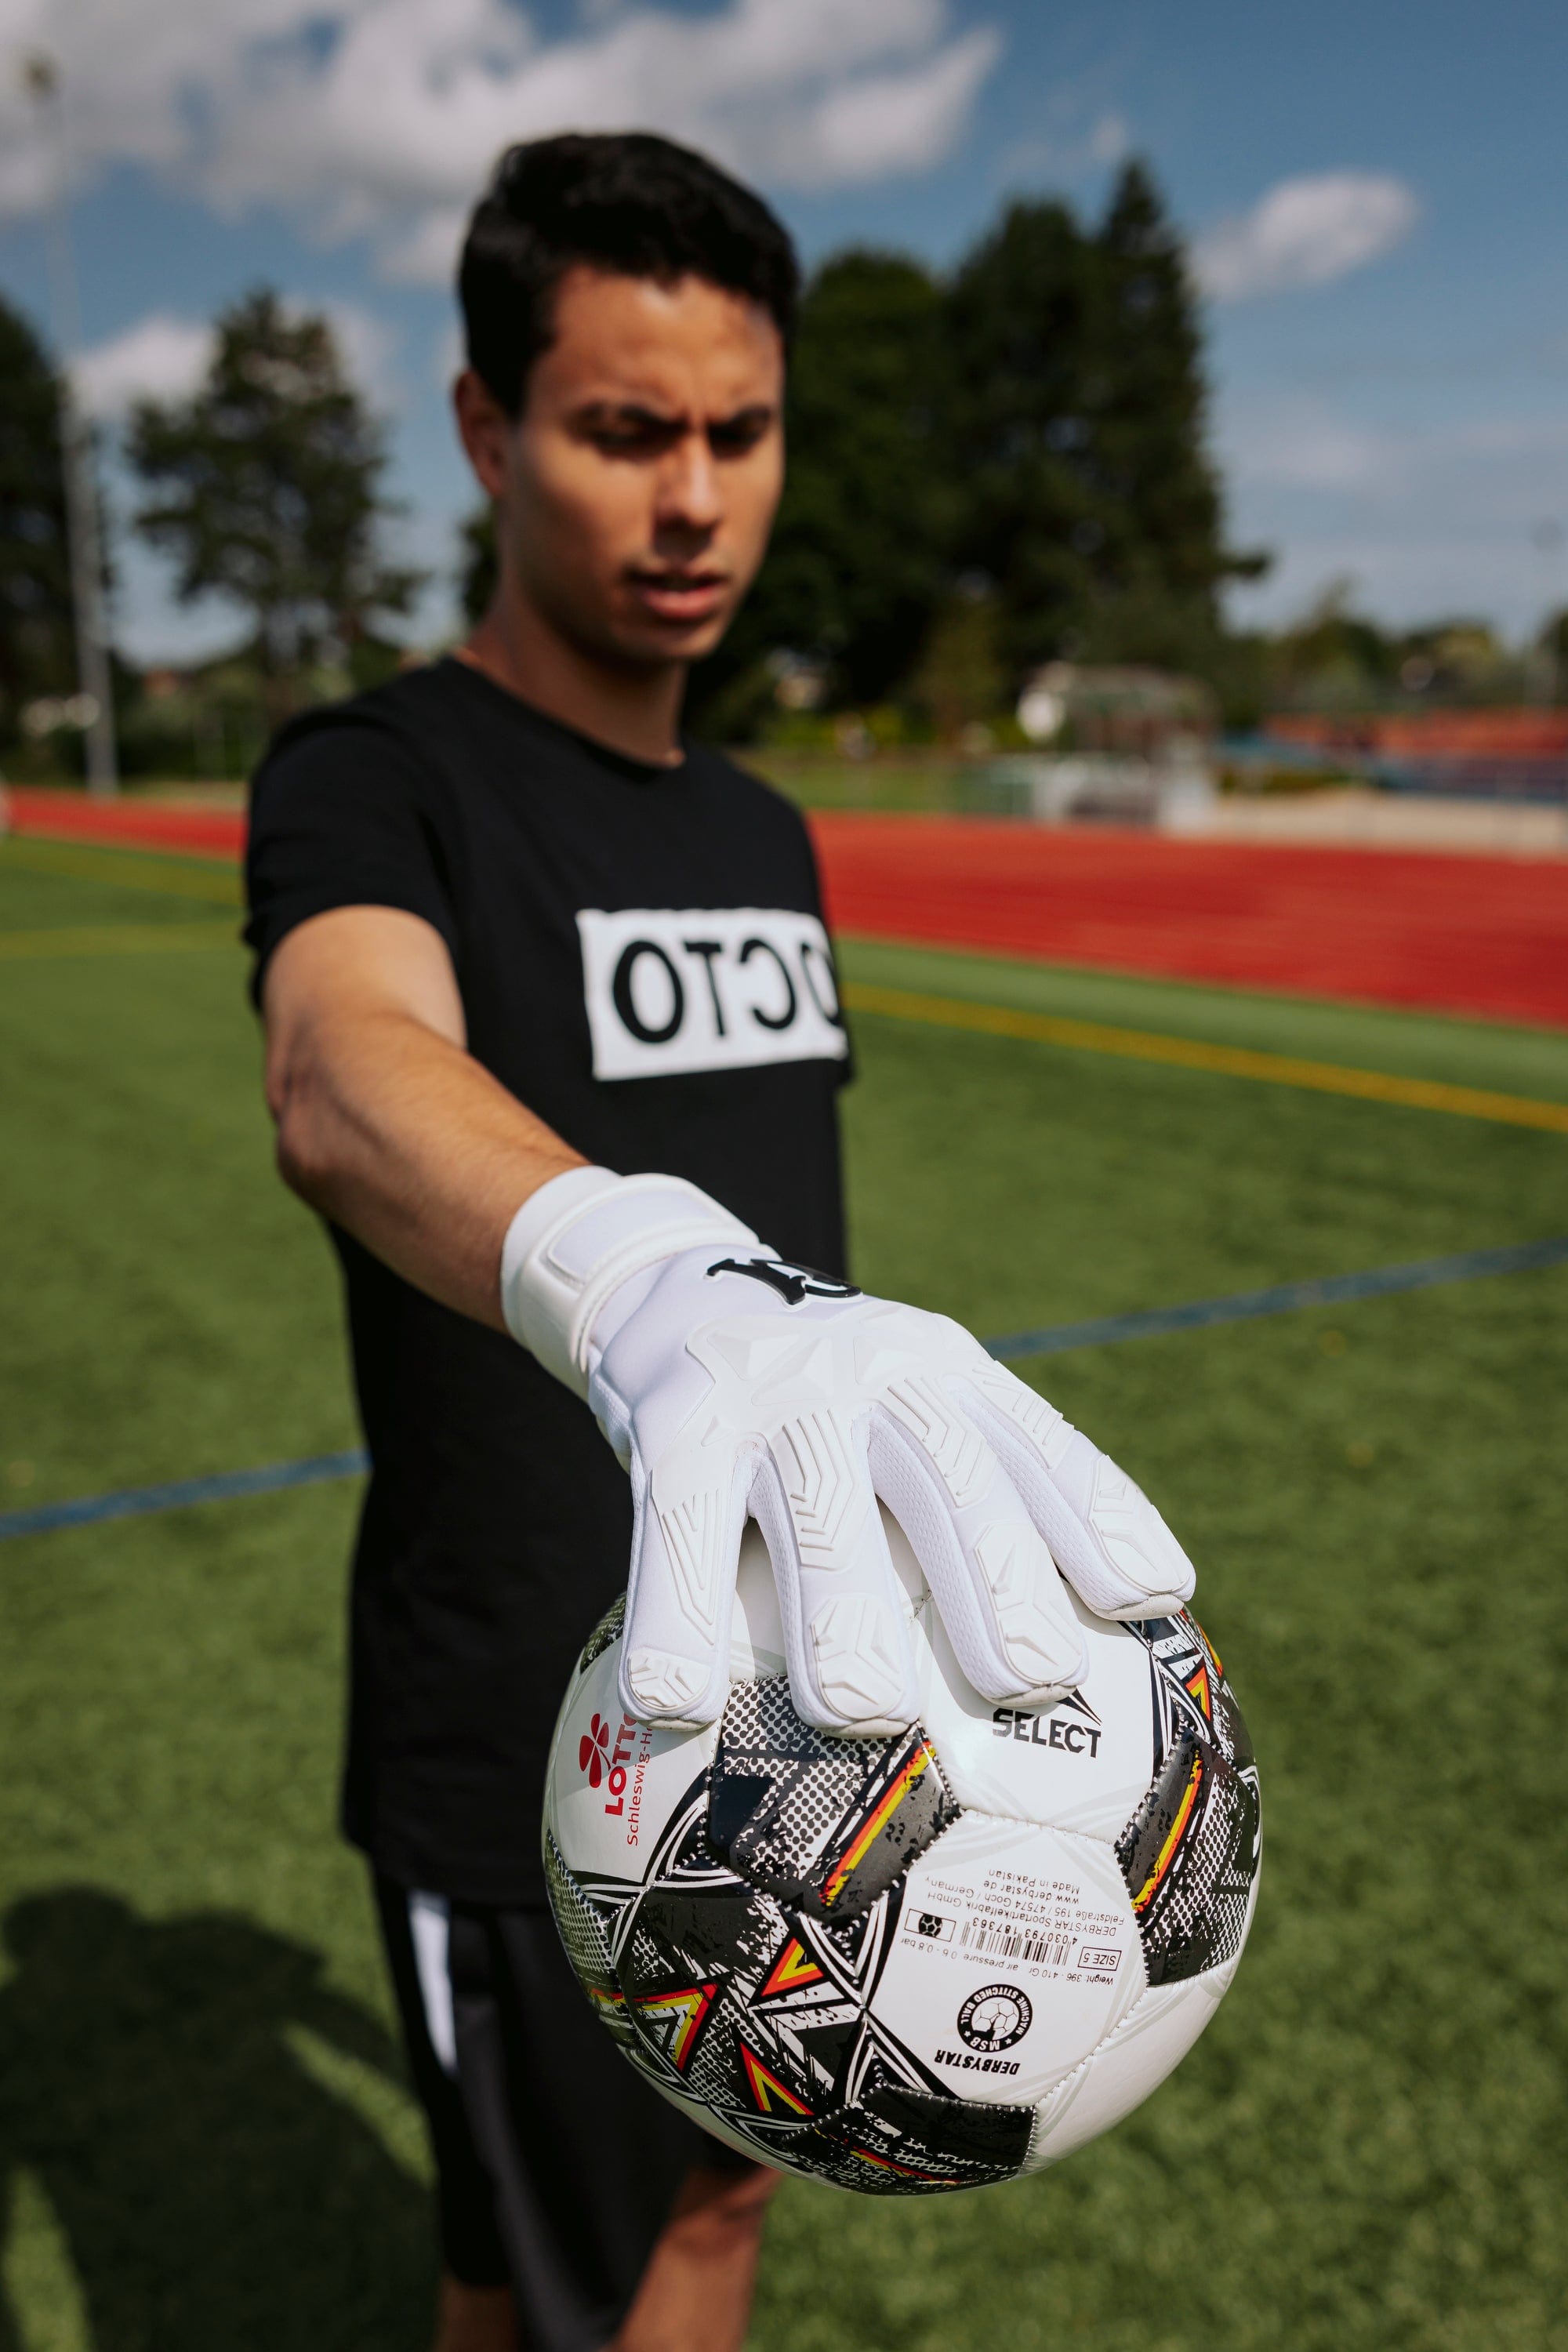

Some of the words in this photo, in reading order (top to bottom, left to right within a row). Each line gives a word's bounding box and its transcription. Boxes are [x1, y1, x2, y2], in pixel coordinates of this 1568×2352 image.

[992, 1708, 1102, 1759] SELECT
[989, 1869, 1036, 1887] Pakistan
[926, 1876, 975, 1898] Germany
[1052, 1882, 1080, 1895] Made
[927, 1892, 962, 1907] GmbH
[985, 1893, 1011, 1907] Goch
[1015, 1900, 1046, 1913] 47574
[966, 1901, 1051, 1928] Sportartikelfabrik
[1054, 1907, 1070, 1918] 195
[1076, 1910, 1125, 1926] Feldstraße
[1054, 1921, 1116, 1936] DERBYSTAR
[901, 1937, 916, 1947] bar
[963, 1954, 1004, 1968] pressure
[1083, 1952, 1091, 1963] 5
[1092, 1953, 1116, 1965] SIZE
[1042, 1969, 1058, 1978] 410
[1066, 1973, 1082, 1983] 396
[973, 1987, 1019, 2003] STITCHED
[960, 2002, 976, 2024] BALL
[1015, 1996, 1030, 2035] MACHINE
[970, 2036, 1000, 2051] MSB
[934, 2049, 1021, 2075] DERBYSTAR
